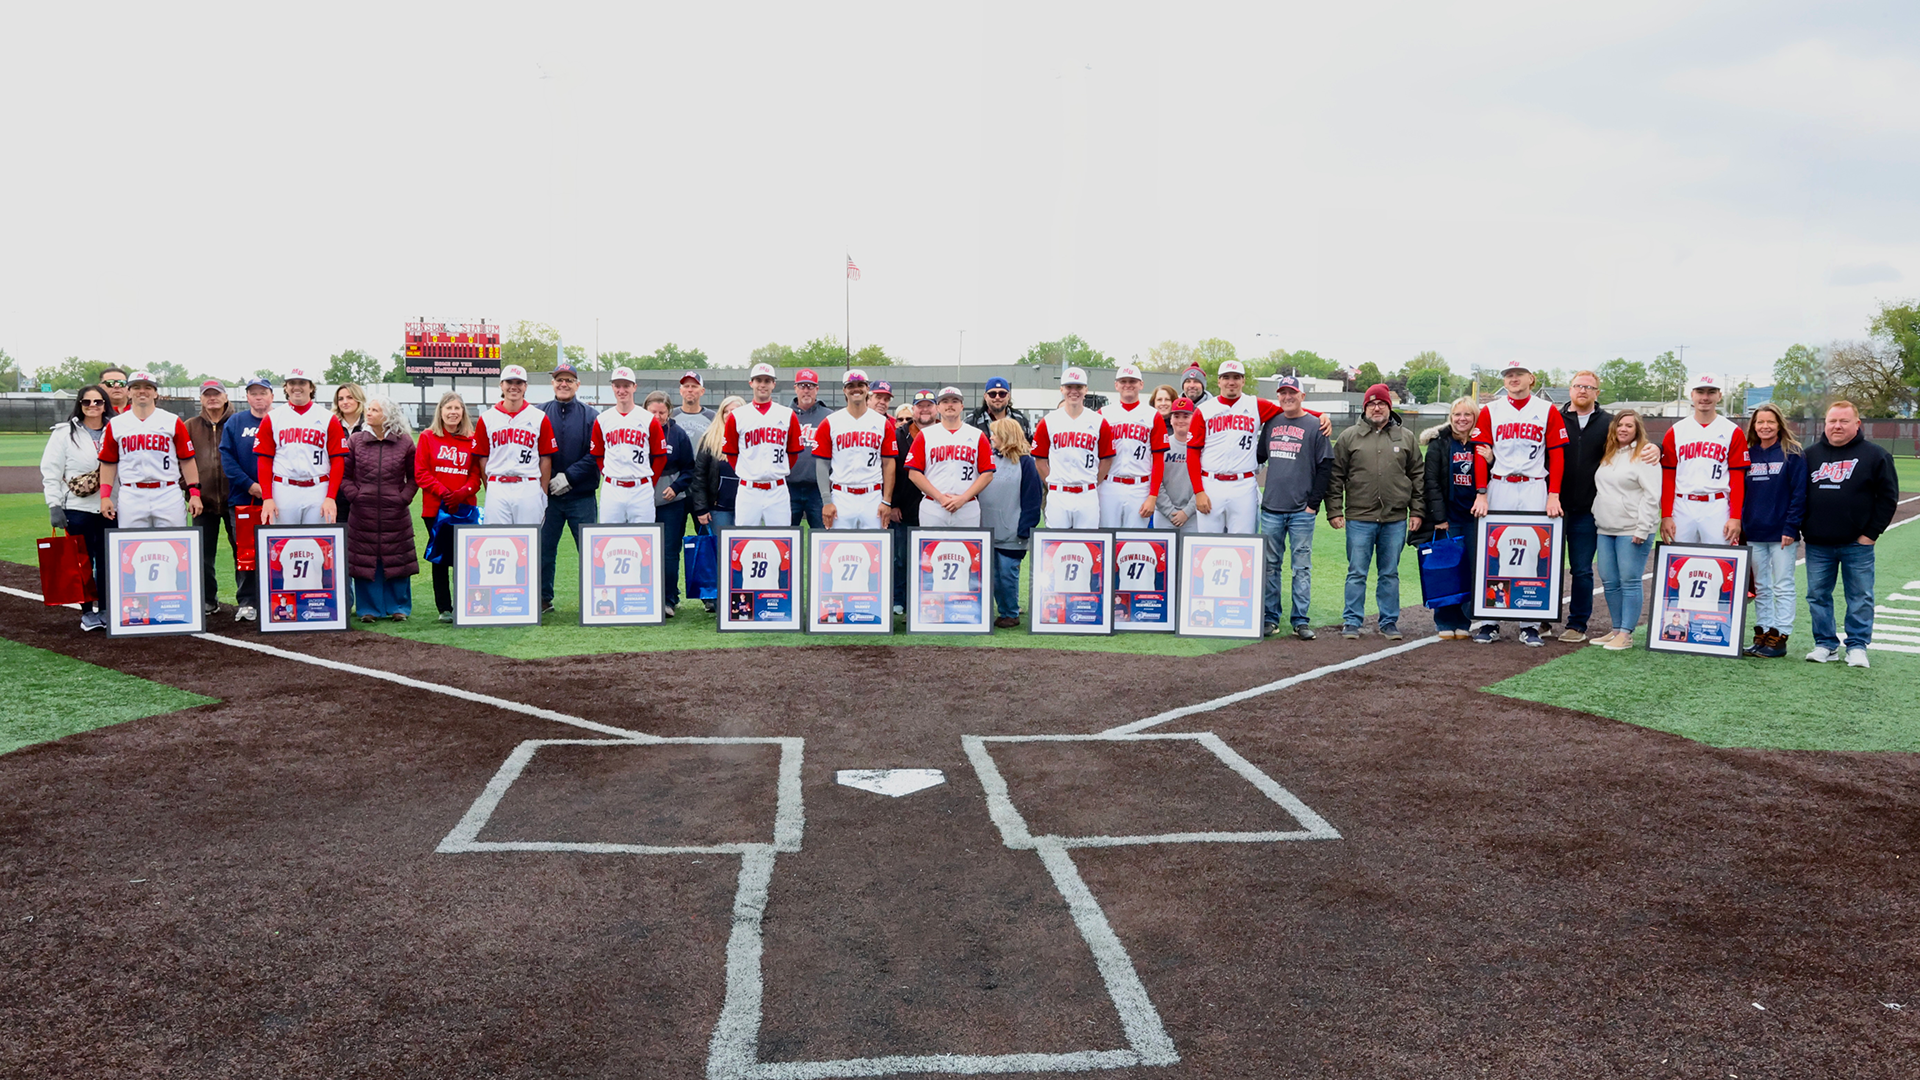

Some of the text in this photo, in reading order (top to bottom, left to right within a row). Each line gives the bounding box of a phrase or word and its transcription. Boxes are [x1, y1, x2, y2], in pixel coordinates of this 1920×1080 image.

[405, 322, 500, 333] MUNSON STADIUM
[1208, 414, 1254, 436] PIONEERS
[1271, 425, 1305, 440] MALONE
[1496, 422, 1544, 442] PIONEERS
[122, 434, 170, 454] PIONEERS
[279, 428, 326, 449] PIONEERS
[492, 428, 536, 448] PIONEERS
[606, 428, 647, 448] PIONEERS
[744, 427, 786, 448] PIONEERS
[836, 431, 882, 451] PIONEERS
[1053, 432, 1096, 452] PIONEERS
[1239, 436, 1252, 450] 45
[313, 450, 323, 466] 51
[438, 446, 468, 466] MU
[519, 450, 532, 464] 56
[632, 450, 644, 464] 26
[772, 449, 784, 463] 38
[930, 445, 977, 465] PIONEERS
[1134, 446, 1147, 460] 47
[1165, 452, 1186, 462] MAL
[1270, 450, 1296, 460] BASEBALL
[1679, 442, 1727, 462] PIONEERS
[163, 456, 170, 470] 6
[1085, 454, 1094, 468] 13
[435, 466, 468, 476] BASEBALL
[961, 466, 974, 480] 32
[1711, 464, 1722, 480] 15
[1820, 464, 1846, 480] MU
[1509, 538, 1527, 546] TYNA
[140, 554, 170, 563] ALVAREZ
[290, 550, 314, 560] PHELPS
[486, 549, 510, 558] TODARO
[606, 548, 638, 558] SHUMAKER
[838, 555, 862, 564] VARNEY
[938, 554, 964, 562] WHEELER
[1508, 548, 1525, 566] 21
[293, 560, 309, 578] 51
[488, 558, 506, 574] 56
[614, 558, 631, 574] 26
[750, 561, 768, 578] 38
[841, 564, 858, 580] 27
[942, 562, 959, 580] 32
[1127, 562, 1145, 580] 47
[1212, 560, 1232, 568] SMITH
[148, 564, 160, 581] 6
[1064, 564, 1078, 581] 13
[1212, 569, 1230, 586] 45
[1688, 570, 1712, 580] BUNCH
[1690, 580, 1708, 598] 15
